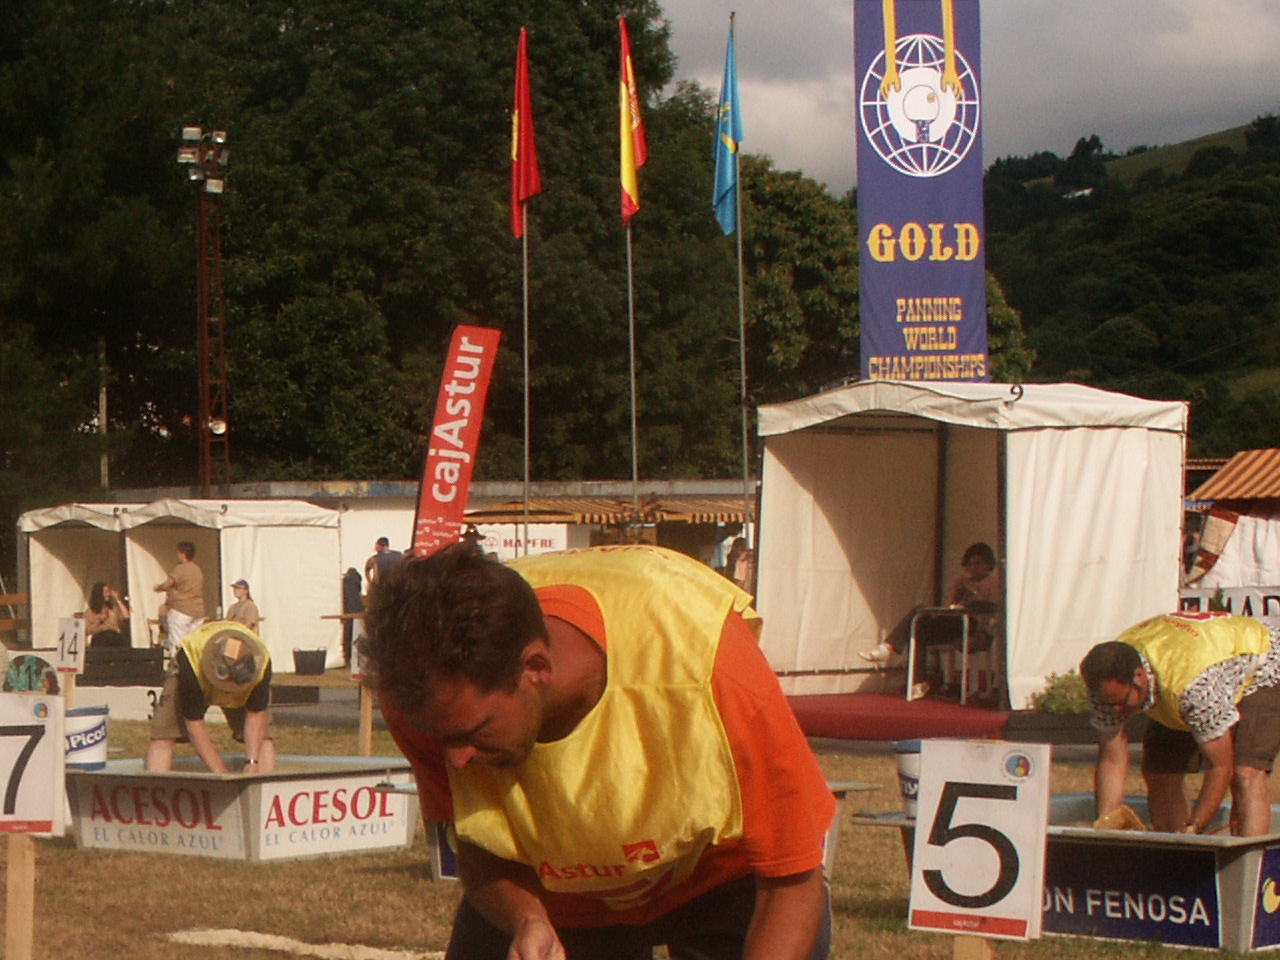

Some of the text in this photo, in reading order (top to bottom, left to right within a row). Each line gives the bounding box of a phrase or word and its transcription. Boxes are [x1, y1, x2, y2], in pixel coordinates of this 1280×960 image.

[867, 222, 980, 262] GOLD
[896, 297, 962, 322] PANNING
[903, 326, 957, 350] WORLD
[869, 354, 986, 379] CHAMPIONSHIPS
[429, 336, 484, 503] cajAstur
[59, 632, 78, 662] 14
[91, 784, 222, 830] ACESOL
[265, 786, 394, 829] ACESOL
[94, 827, 218, 850] EL CALOR AZUL
[265, 822, 388, 846] EL CALOR AZUL
[922, 781, 1020, 909] 5
[1086, 889, 1210, 926] FENOSA
